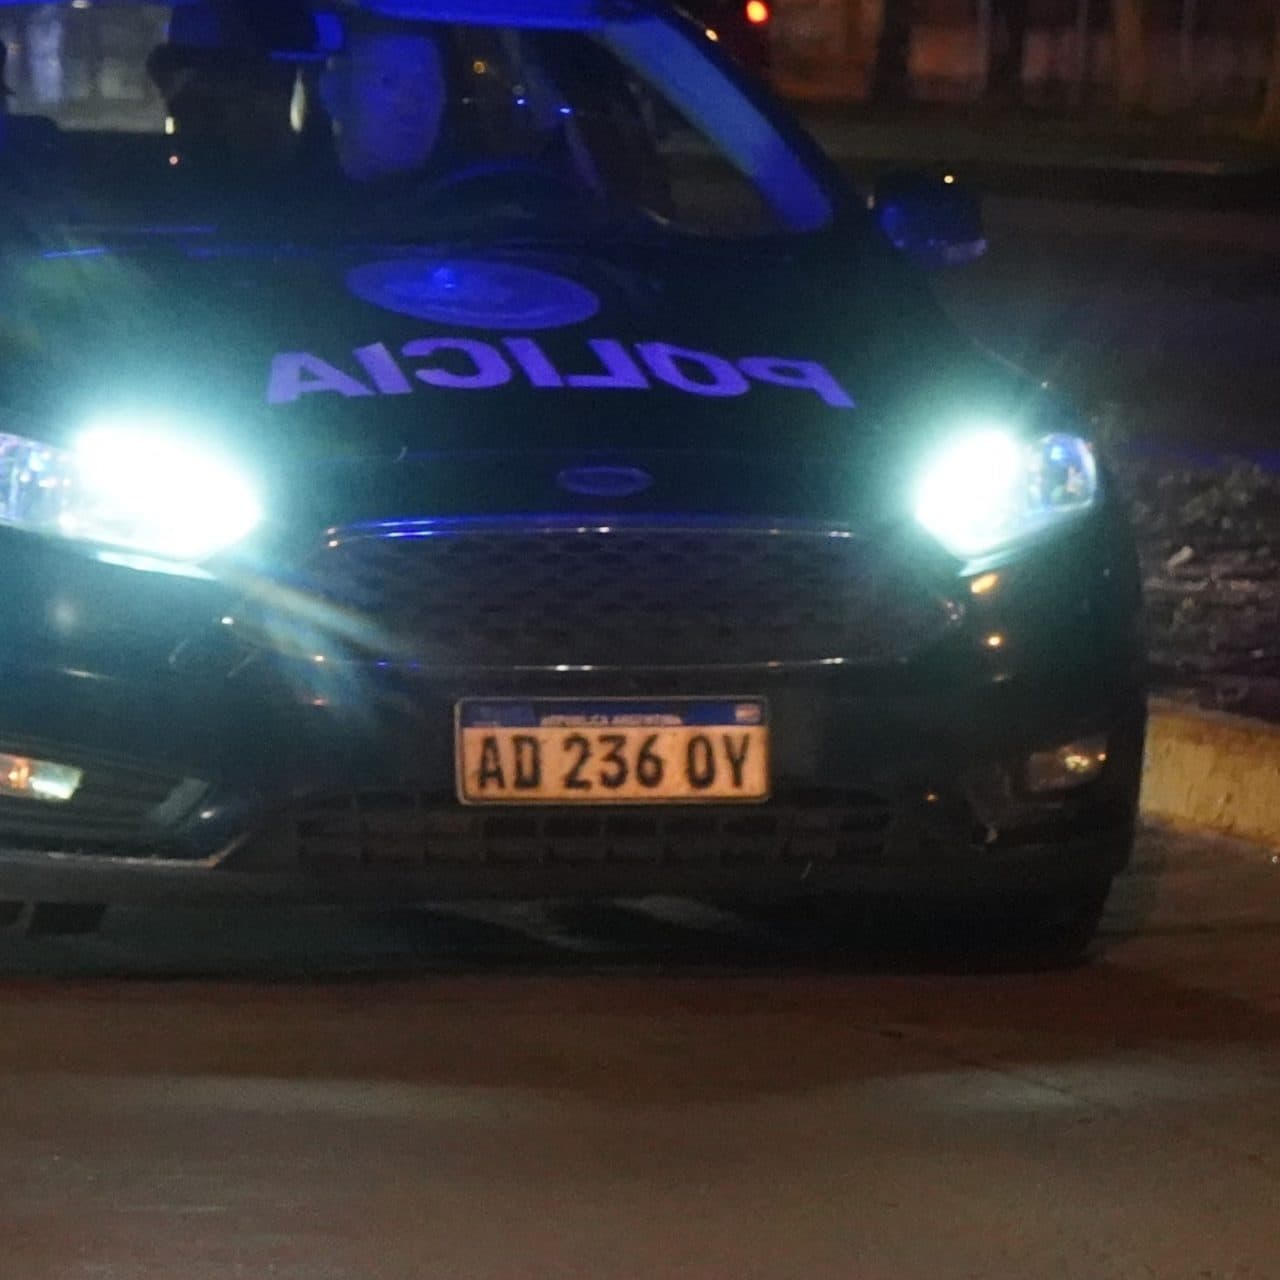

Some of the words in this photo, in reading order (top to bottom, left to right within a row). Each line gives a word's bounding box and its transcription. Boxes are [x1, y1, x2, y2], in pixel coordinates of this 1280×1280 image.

[477, 733, 542, 791] AD
[562, 732, 664, 790] 236
[686, 733, 751, 789] OY
